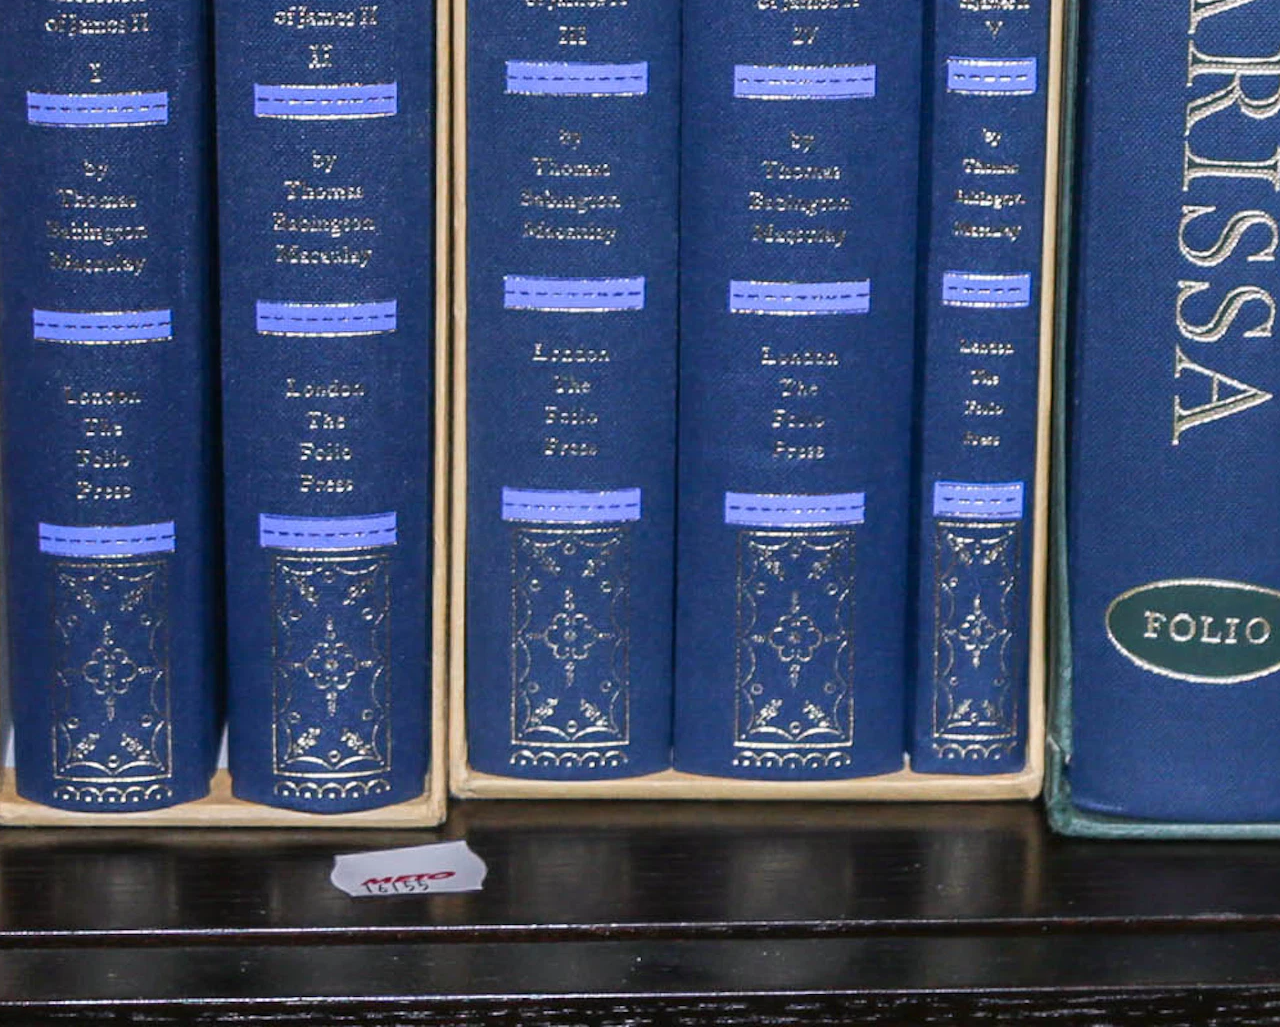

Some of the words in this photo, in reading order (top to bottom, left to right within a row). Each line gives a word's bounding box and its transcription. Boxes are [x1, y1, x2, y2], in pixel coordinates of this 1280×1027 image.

[285, 377, 364, 397] London
[306, 411, 346, 429] The
[1144, 611, 1271, 645] FOLIO
